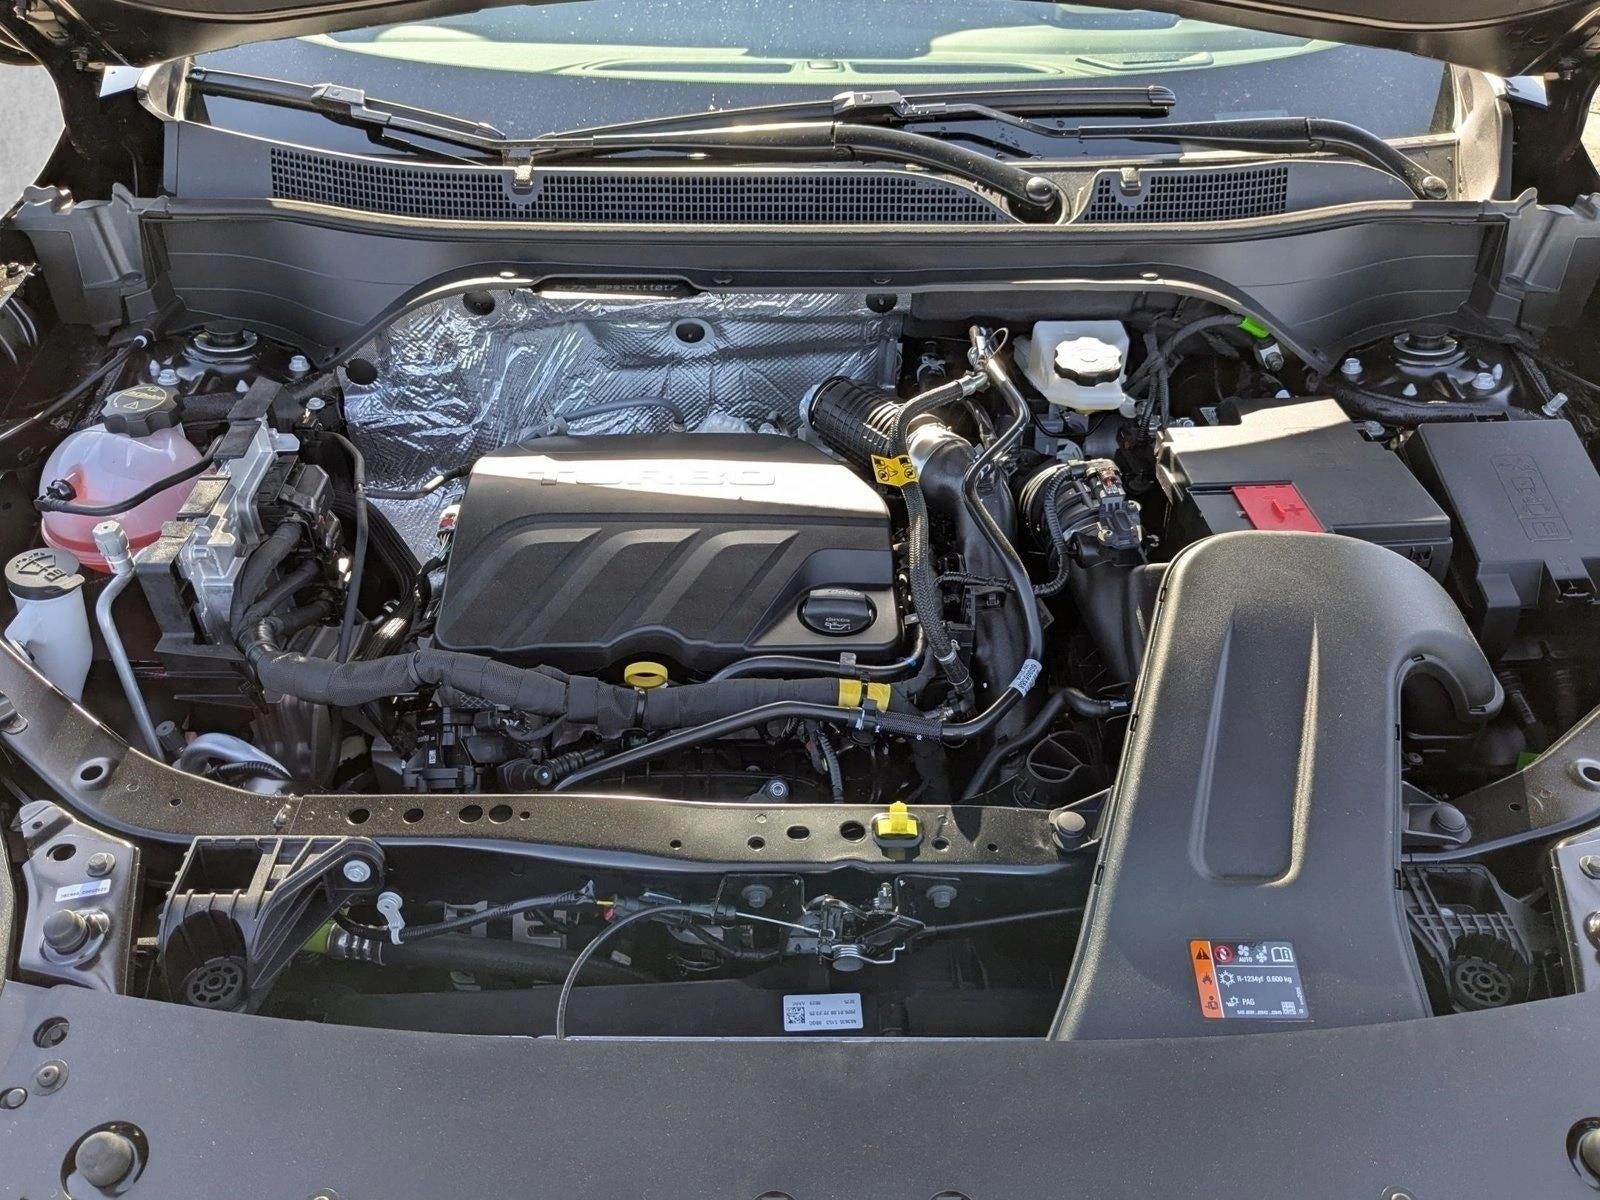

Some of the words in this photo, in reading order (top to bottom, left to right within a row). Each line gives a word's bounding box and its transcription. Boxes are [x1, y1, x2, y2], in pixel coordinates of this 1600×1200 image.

[1237, 975, 1264, 984] R-1234yf
[1266, 975, 1283, 983] 0.600
[1284, 976, 1292, 984] kg
